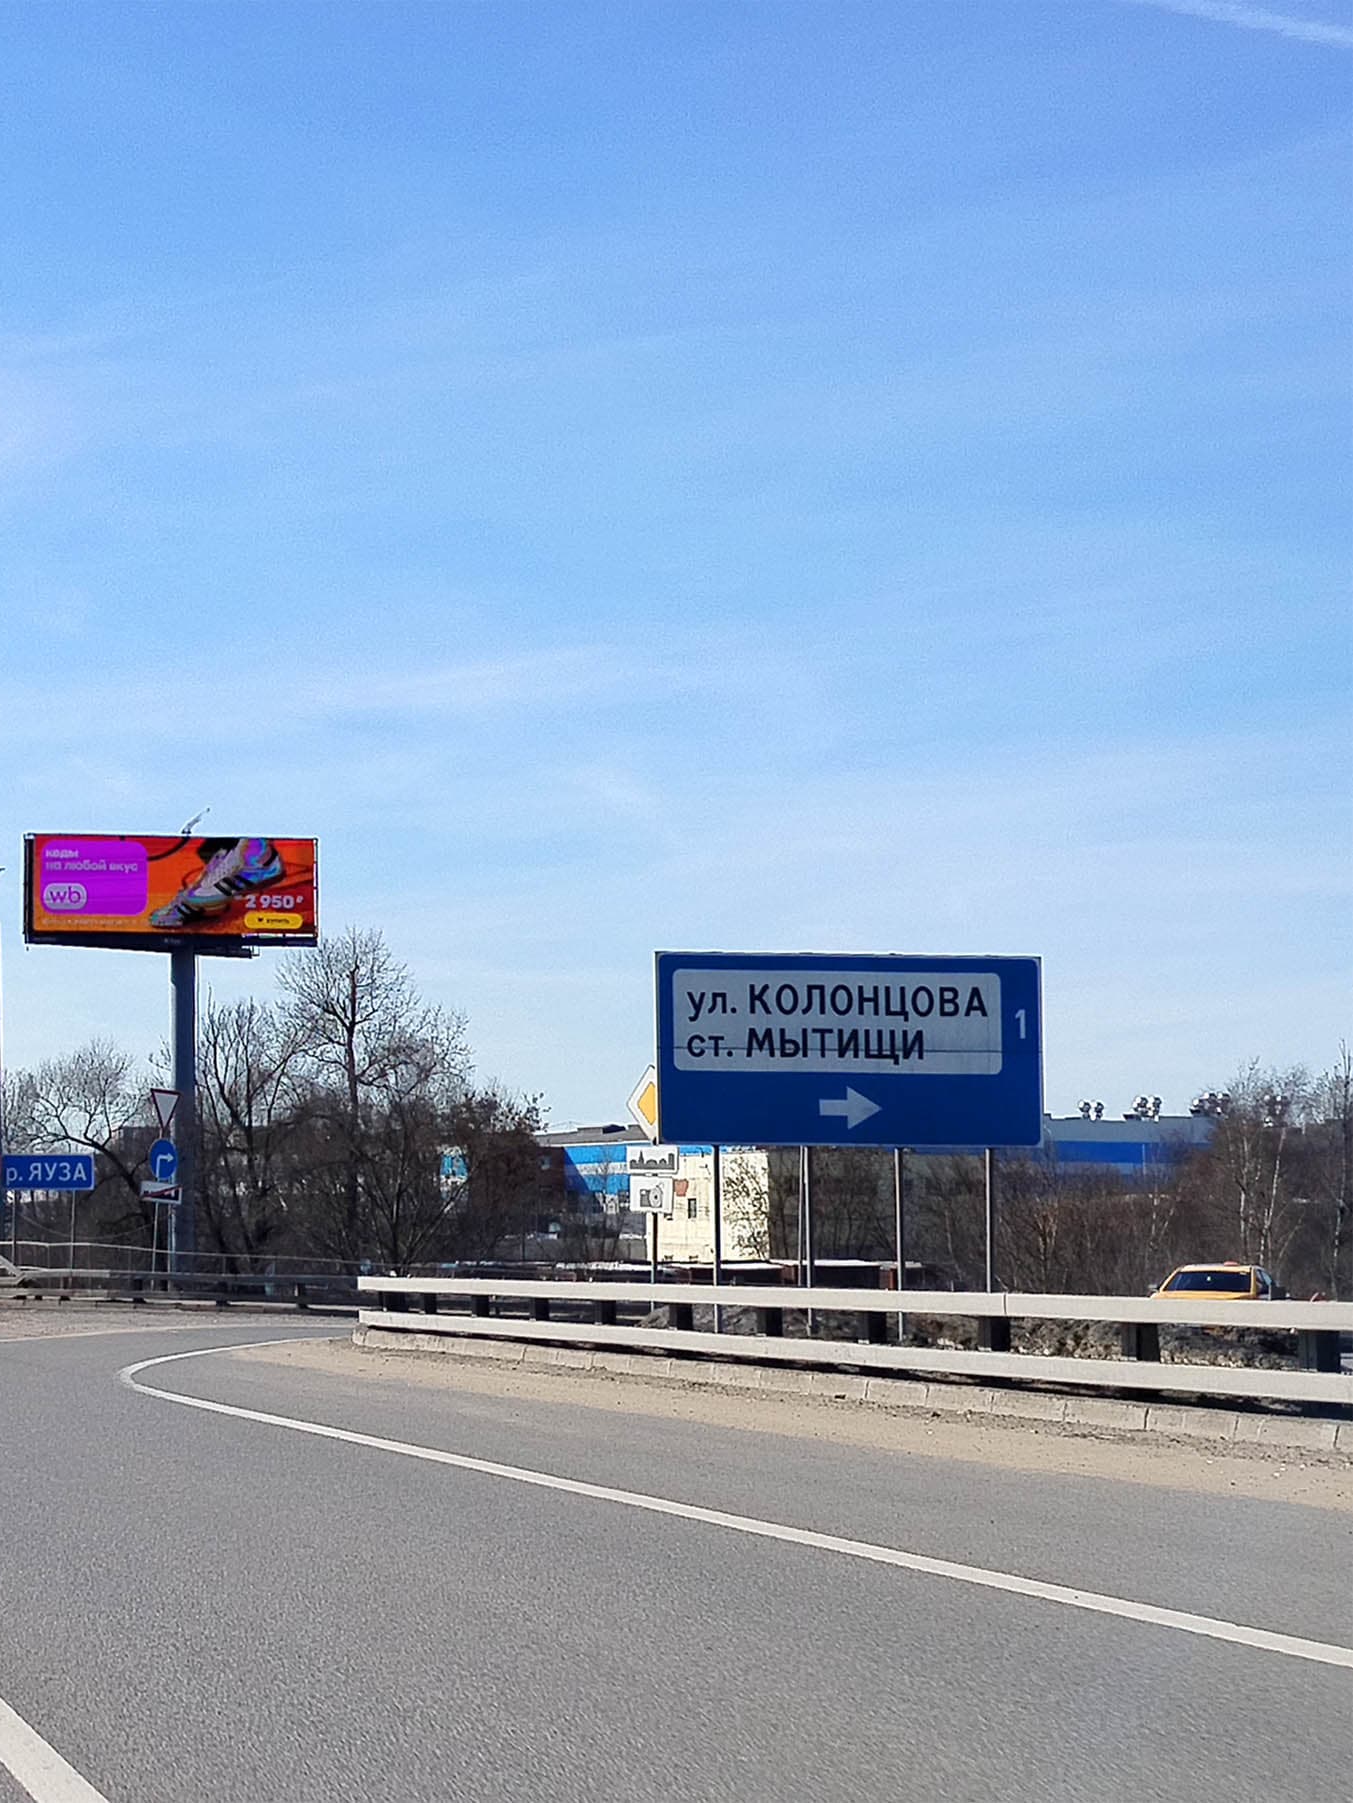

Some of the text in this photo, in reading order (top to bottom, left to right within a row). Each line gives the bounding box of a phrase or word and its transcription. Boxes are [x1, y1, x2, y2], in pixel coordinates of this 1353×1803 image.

[64, 859, 107, 871] любой
[50, 886, 81, 904] wb
[245, 894, 256, 909] 2
[687, 983, 989, 1022] ул. КОЛОНЦОВА
[1015, 1008, 1028, 1040] 1
[686, 1027, 925, 1065] ст. МЫТИЩИ
[6, 1162, 87, 1187] р. ЯУЗА
